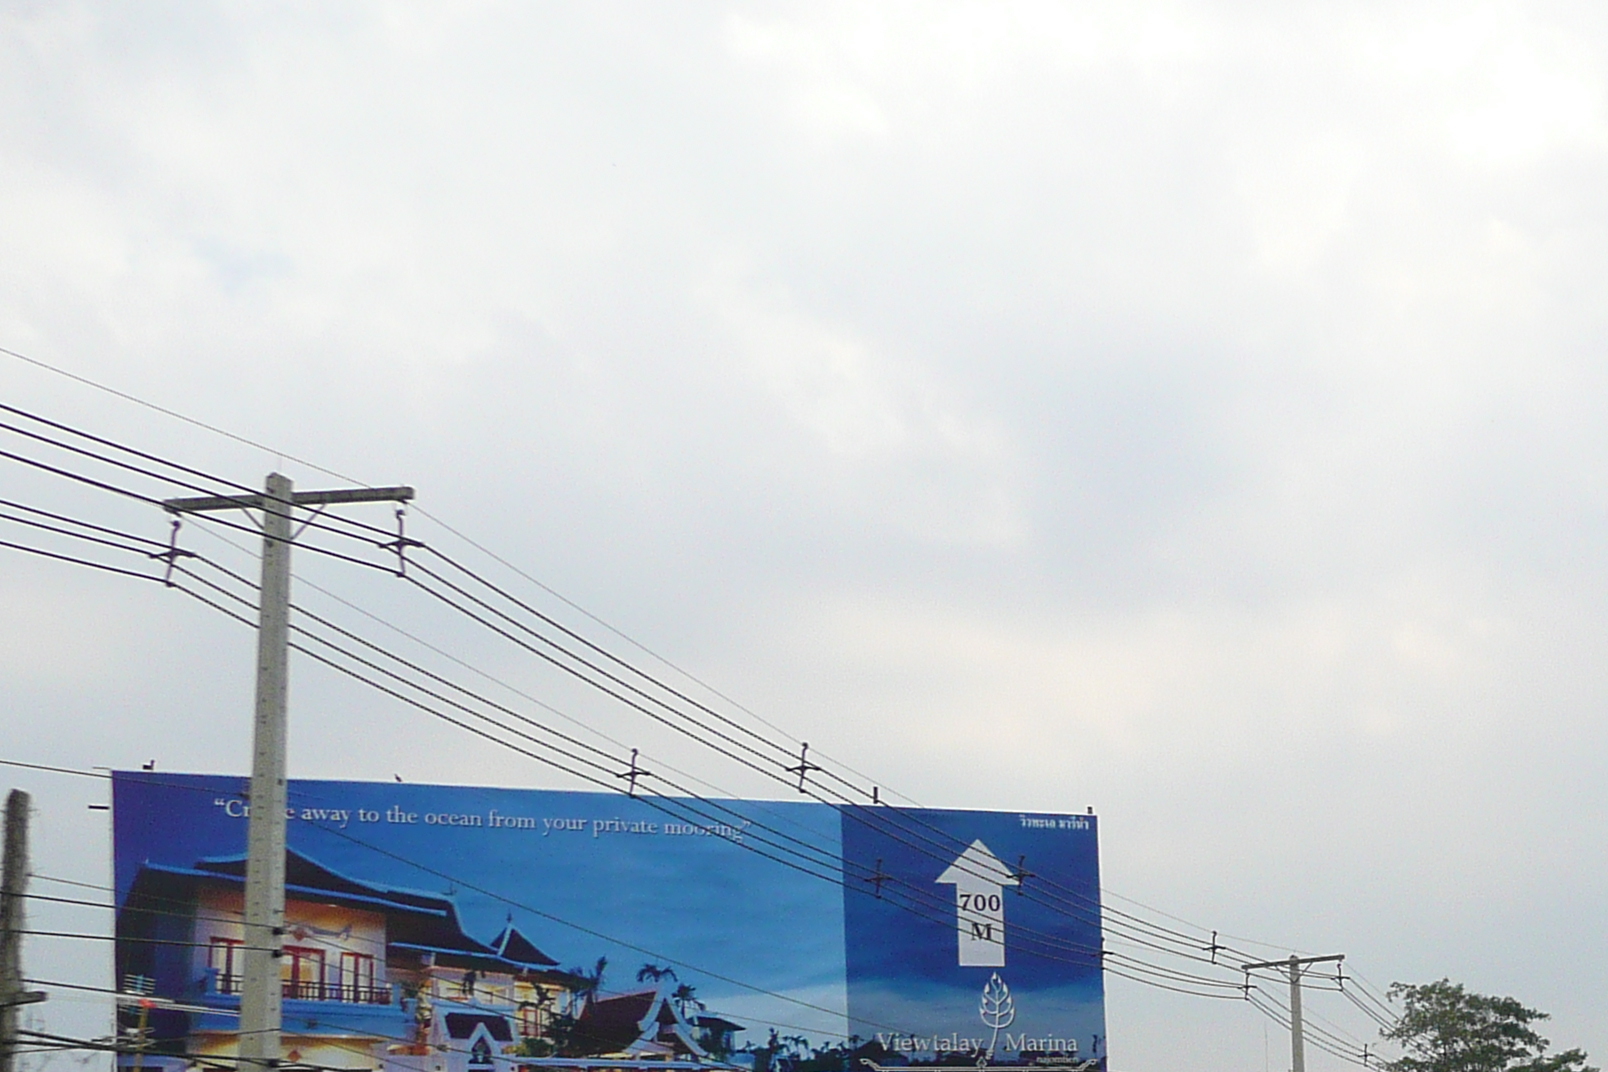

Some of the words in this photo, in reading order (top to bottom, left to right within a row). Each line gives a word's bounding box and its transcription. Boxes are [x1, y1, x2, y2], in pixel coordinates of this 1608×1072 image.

[214, 798, 295, 819] “Cre
[301, 807, 351, 829] away
[358, 806, 380, 824] to
[386, 805, 418, 825] the
[424, 812, 483, 828] ocean
[488, 809, 536, 830] from
[543, 817, 587, 836] your
[593, 817, 658, 838] private
[959, 893, 1001, 912] 700
[971, 922, 993, 941] M
[876, 1031, 984, 1058] Viewtalay
[1005, 1032, 1078, 1052] Marina
